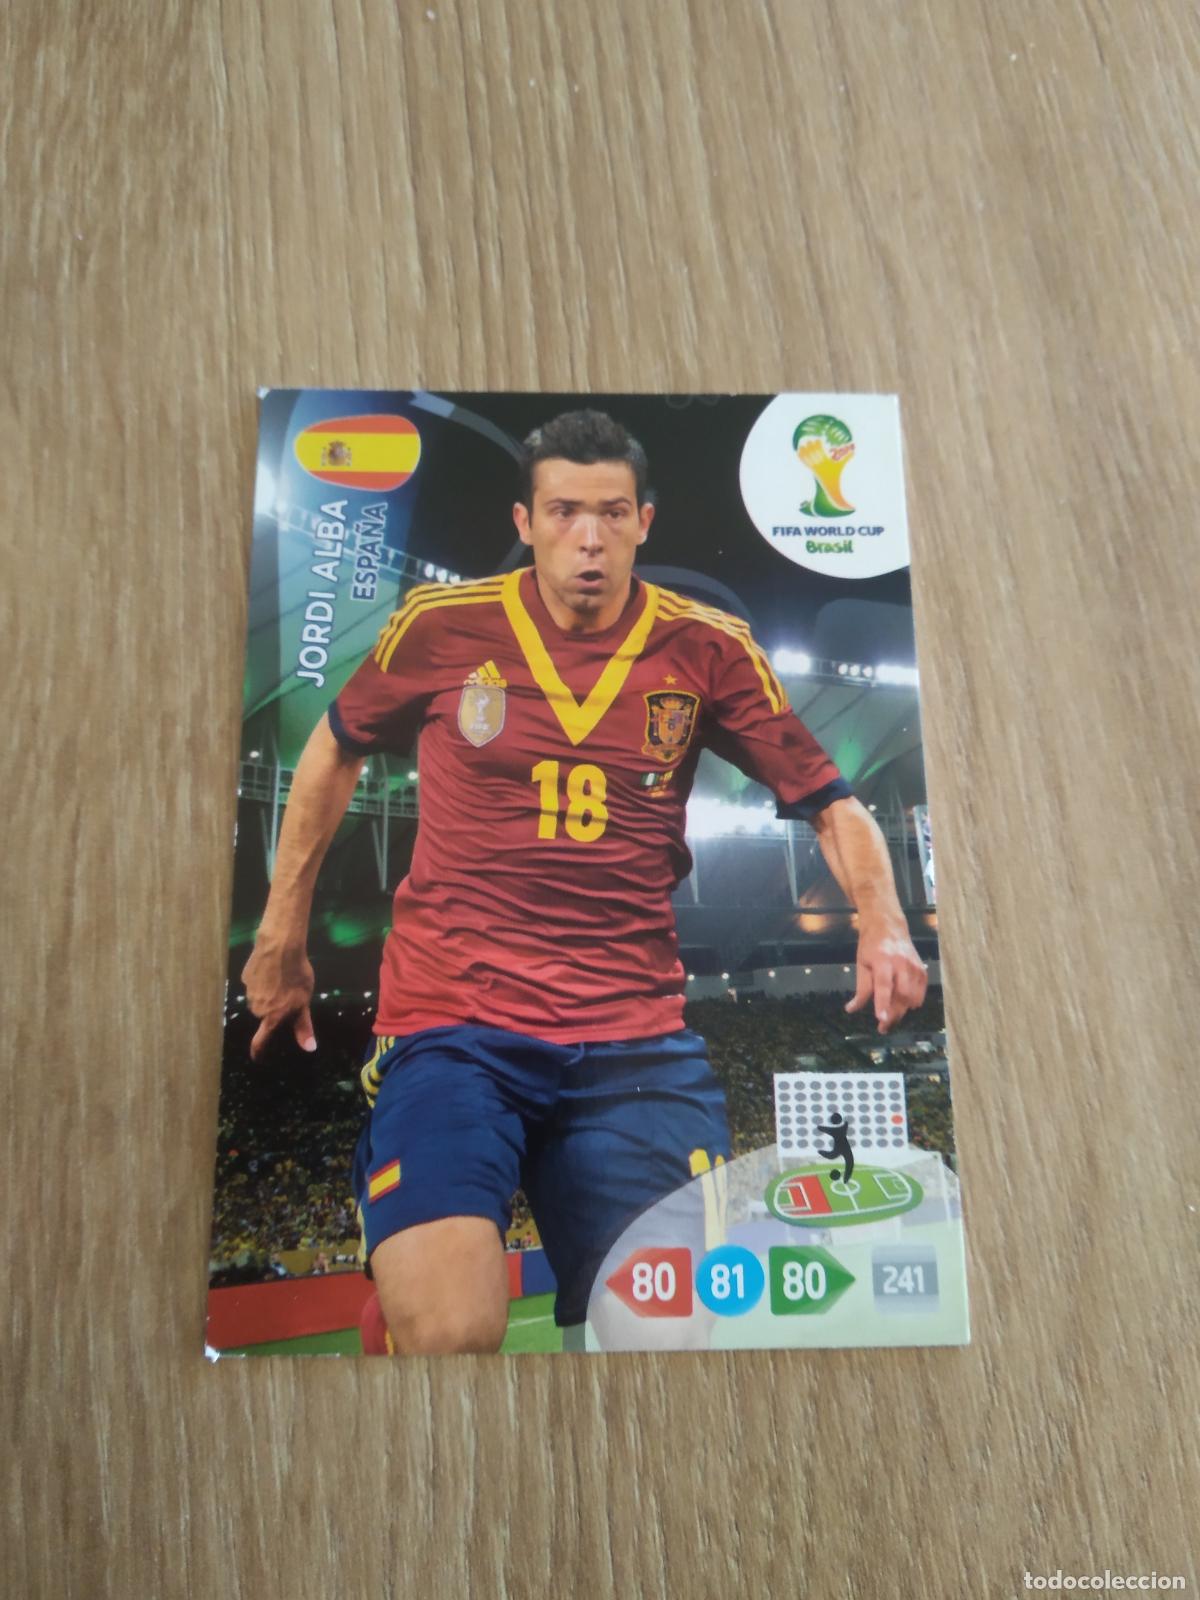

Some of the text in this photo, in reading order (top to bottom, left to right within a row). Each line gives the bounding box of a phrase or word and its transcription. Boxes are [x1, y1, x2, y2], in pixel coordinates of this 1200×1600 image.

[351, 501, 388, 601] ESPAÑA
[772, 526, 885, 537] FIFA WORLD CUP
[806, 540, 854, 553] Brasil
[297, 500, 348, 688] JORDI ALBA
[531, 760, 608, 843] 18
[632, 1261, 827, 1302] 80 81 80
[882, 1265, 925, 1294] 241
